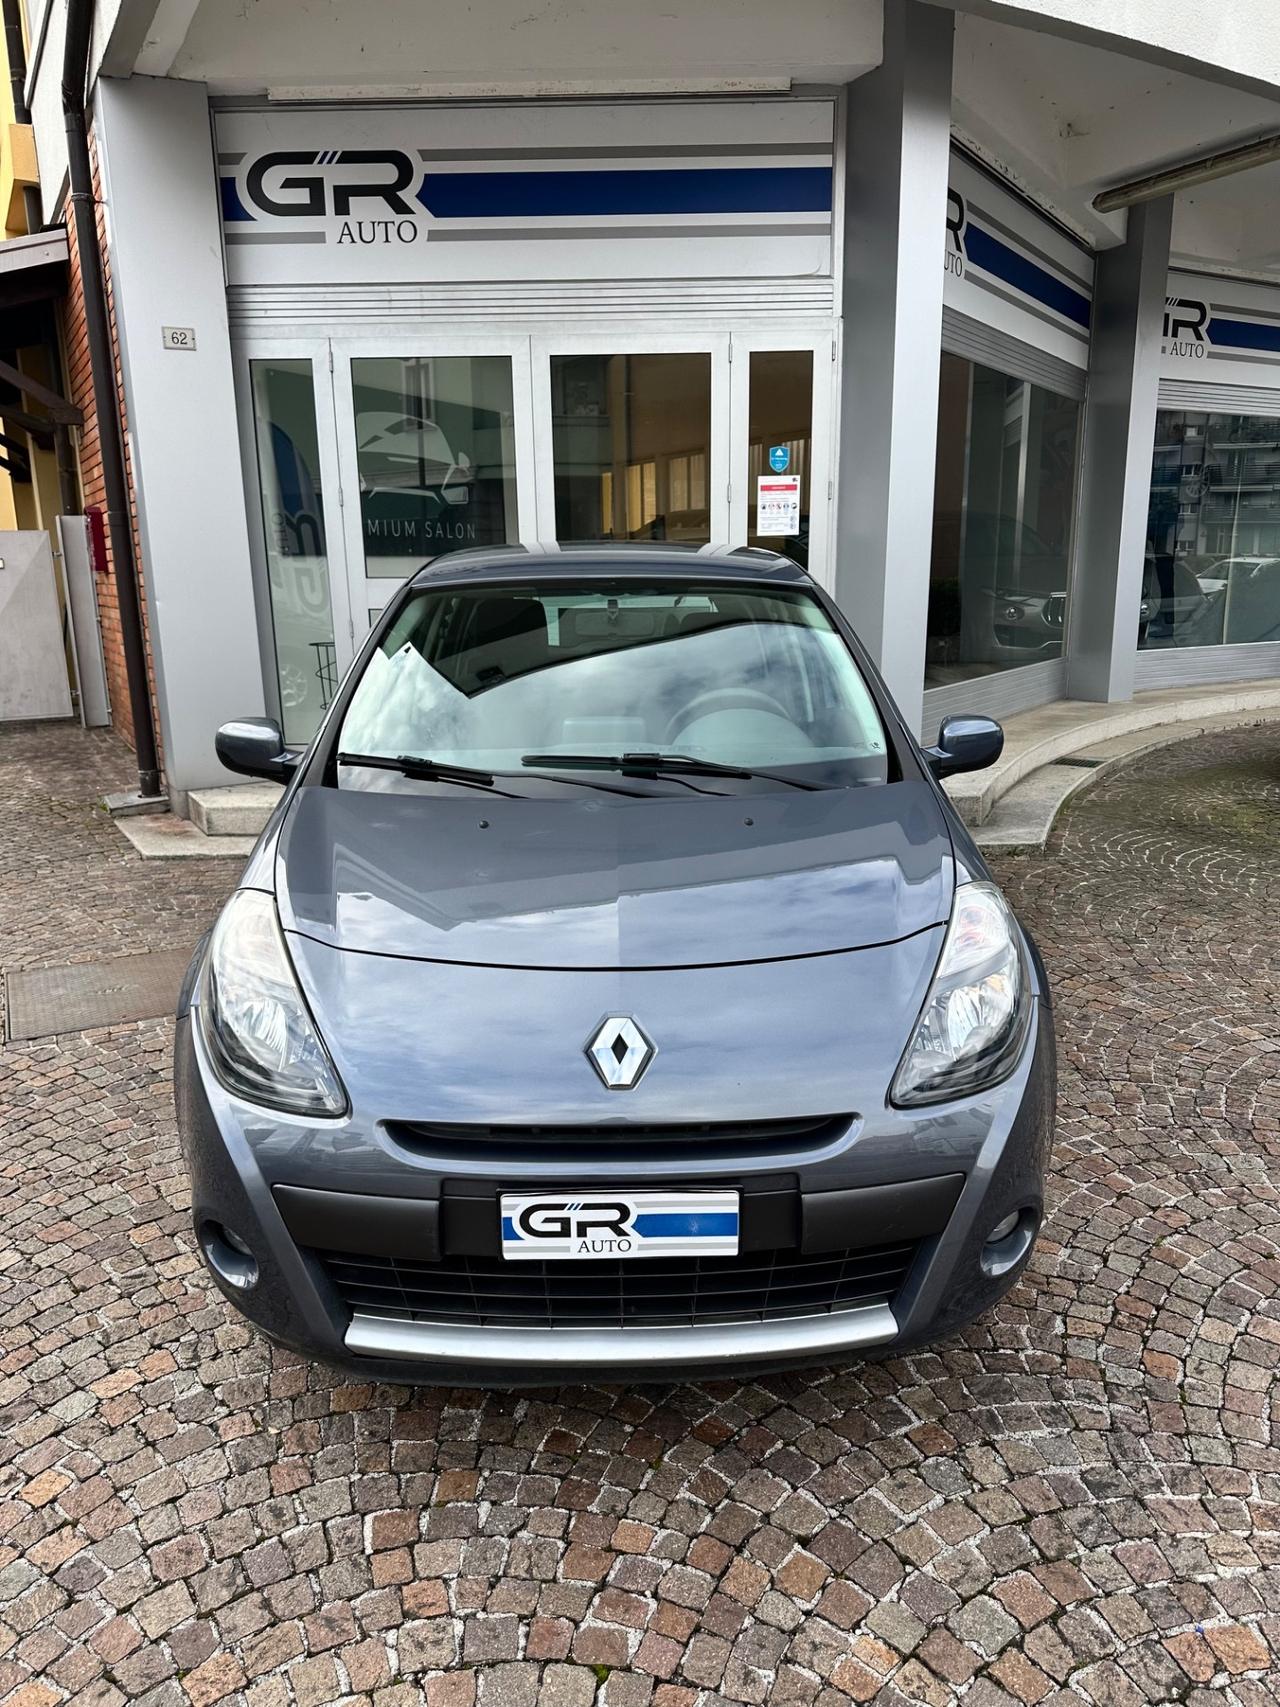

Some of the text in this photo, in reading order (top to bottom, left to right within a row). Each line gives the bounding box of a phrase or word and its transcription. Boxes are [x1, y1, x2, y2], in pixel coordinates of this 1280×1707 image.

[246, 150, 417, 217] GR
[337, 220, 418, 244] AUTO
[1163, 297, 1207, 341] R
[171, 331, 188, 345] 62
[1170, 341, 1205, 359] AUTO
[425, 521, 476, 540] SALON
[519, 1202, 632, 1238] GR
[577, 1239, 632, 1254] AUTO
